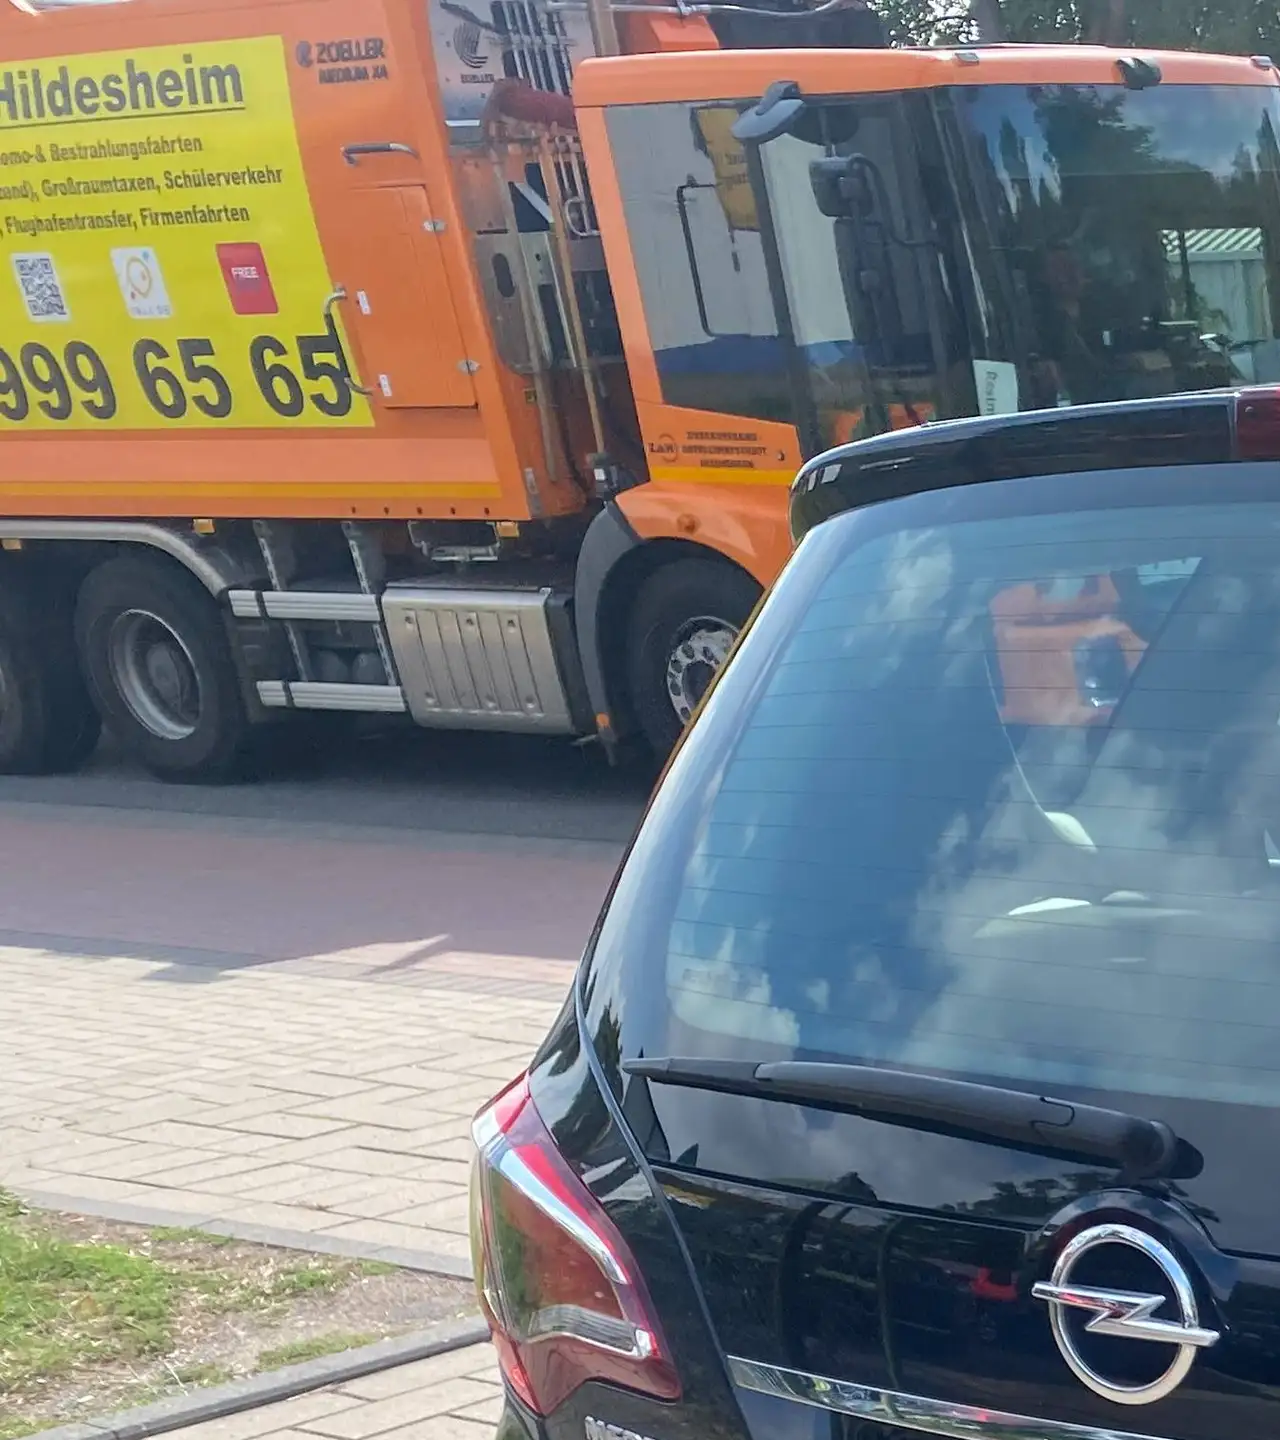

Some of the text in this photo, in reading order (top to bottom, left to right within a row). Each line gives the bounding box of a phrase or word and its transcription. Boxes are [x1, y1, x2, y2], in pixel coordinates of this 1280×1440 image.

[315, 38, 385, 64] ZOELLER
[0, 53, 245, 121] Hildesheim
[49, 135, 203, 162] Bestrahlungsfahrten
[41, 174, 161, 197] Großraumtaxen,
[163, 165, 283, 190] Schülerverkehr
[139, 203, 251, 226] Firmenfahrten
[132, 338, 232, 419] 65
[249, 335, 352, 418] 65
